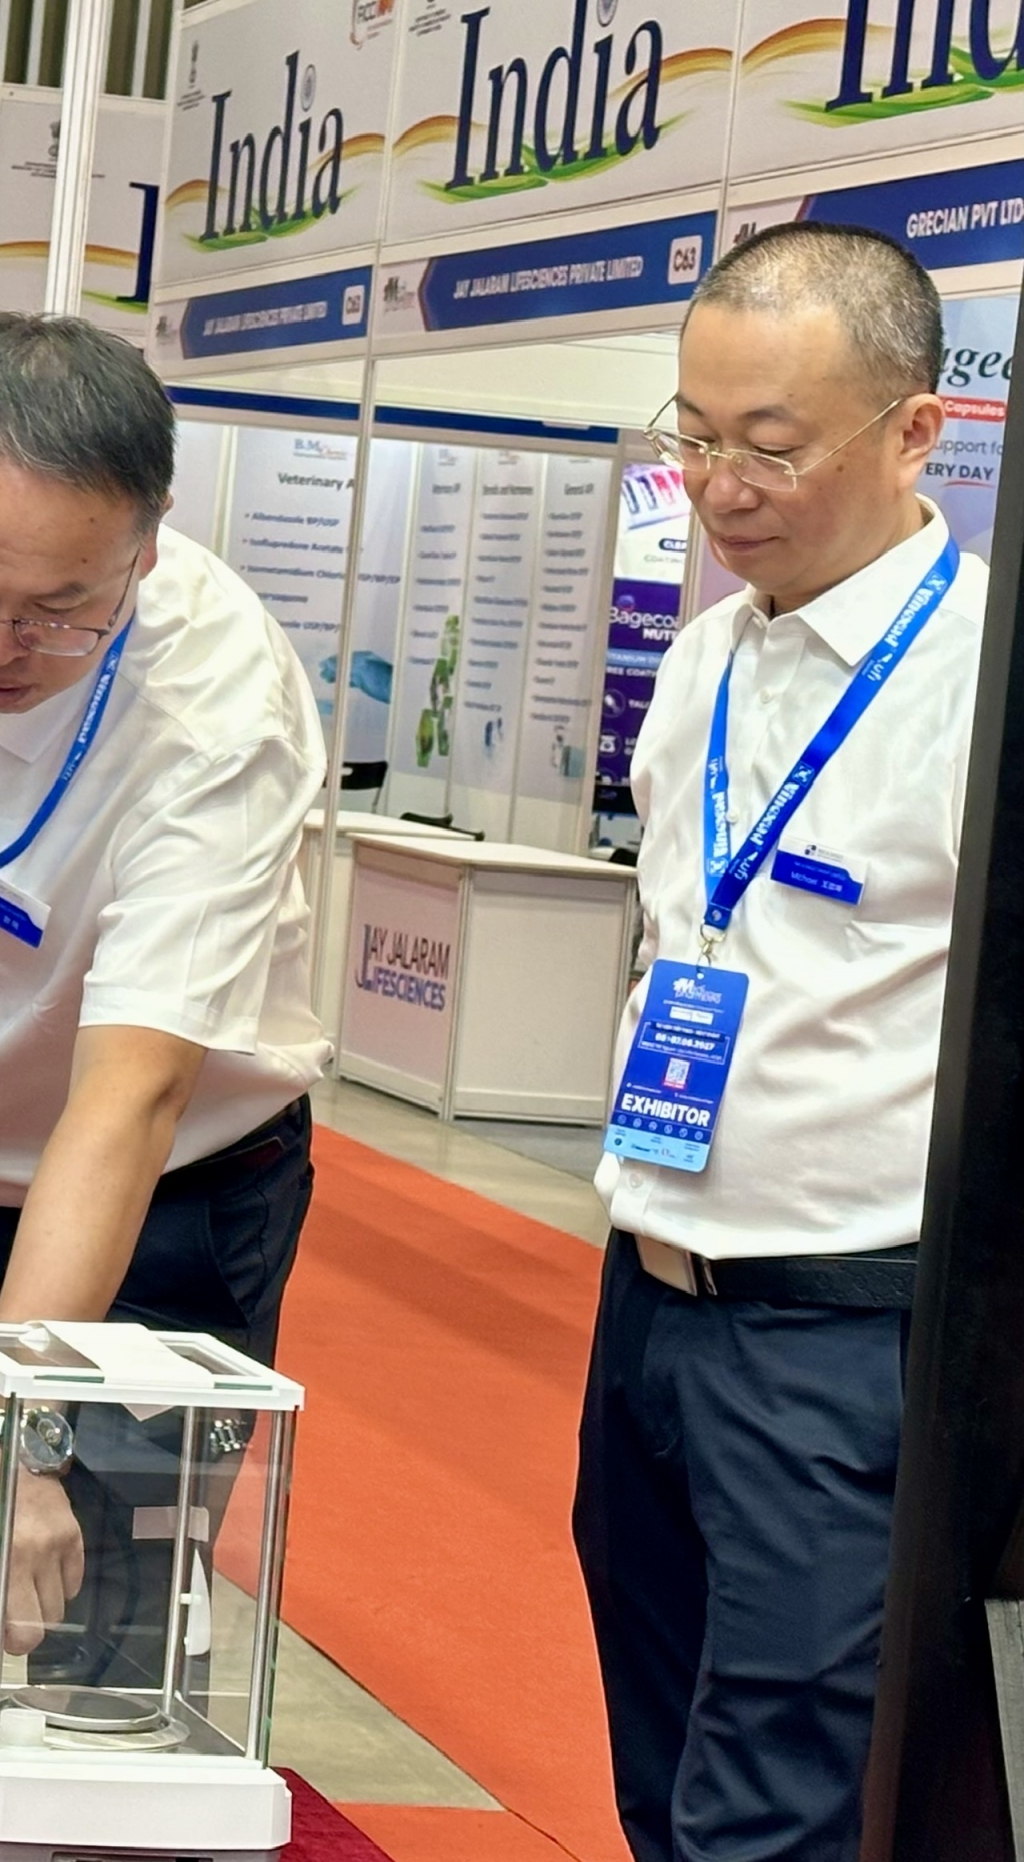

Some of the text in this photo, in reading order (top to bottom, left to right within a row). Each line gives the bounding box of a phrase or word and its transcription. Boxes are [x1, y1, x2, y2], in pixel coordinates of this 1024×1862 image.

[444, 0, 663, 192] India
[199, 51, 344, 243] India
[906, 206, 968, 239] GRECIAN
[970, 202, 998, 230] PVT
[453, 247, 696, 299] JAY JALARAM LIFESCIENCES PRIVATE LIMITED C63
[945, 400, 1006, 418] Capsules
[934, 439, 1003, 456] upport fo
[278, 472, 356, 491] Veterinary A
[926, 462, 995, 481] ERY DAY
[387, 931, 451, 980] JALARAM
[363, 966, 447, 1011] LIFESCIENCES
[621, 1093, 711, 1127] EXHIBITOR
